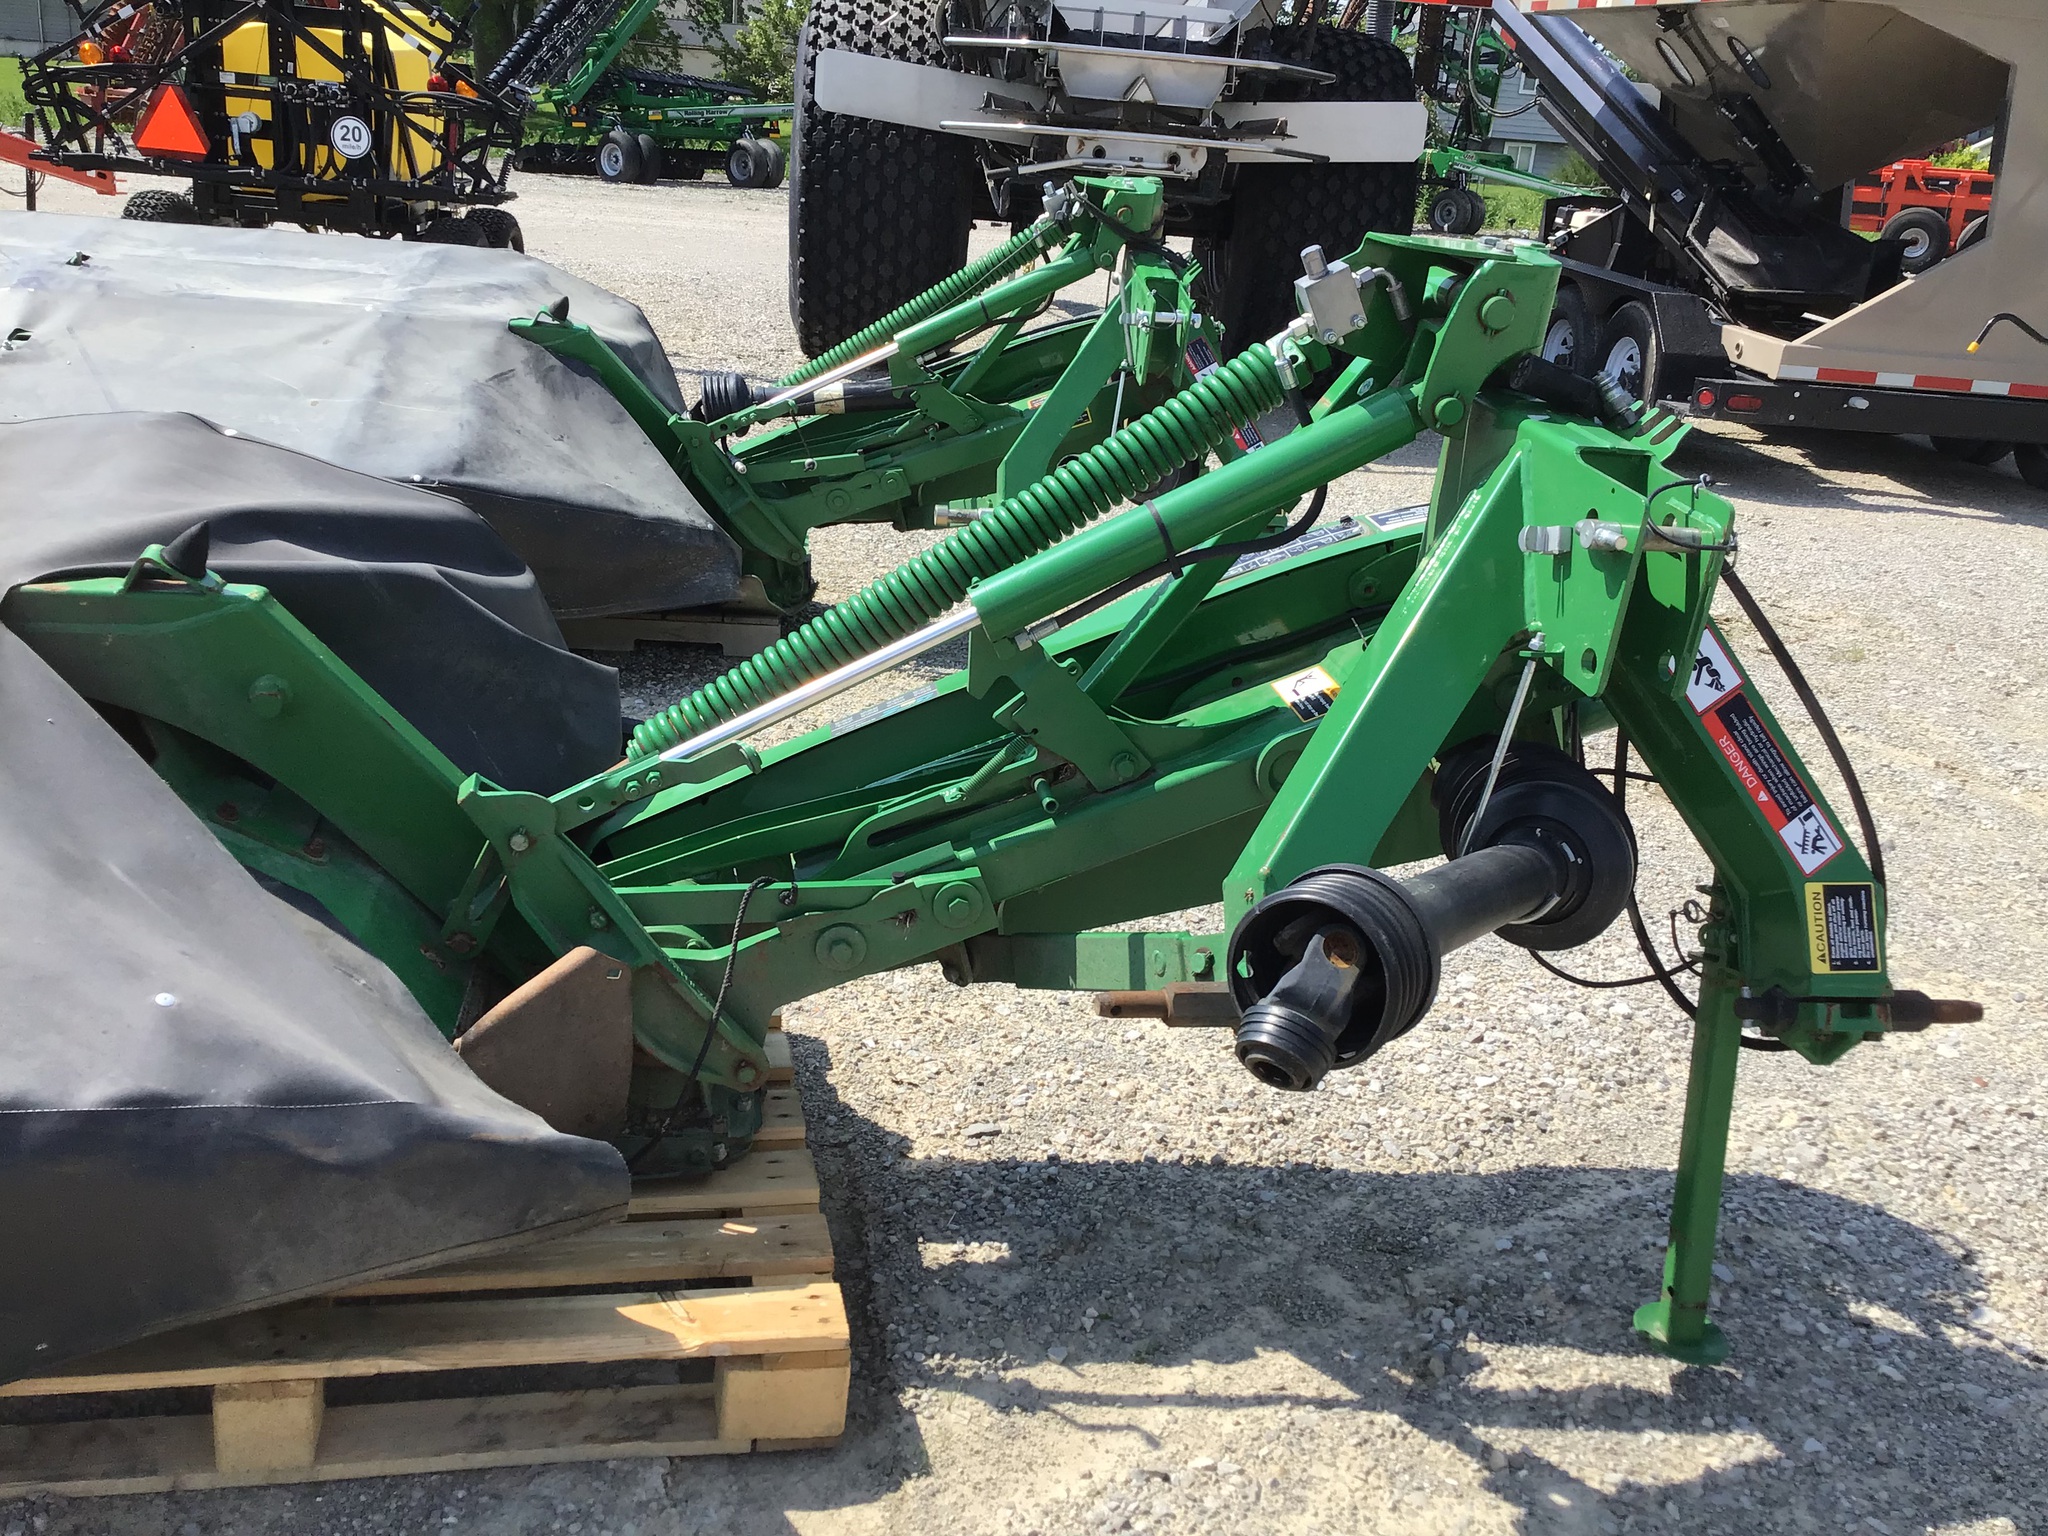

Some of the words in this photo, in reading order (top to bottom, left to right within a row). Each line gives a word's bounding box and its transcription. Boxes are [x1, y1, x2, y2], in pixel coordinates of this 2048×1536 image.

[340, 124, 362, 142] 20
[1730, 713, 1743, 730] folded
[1733, 730, 1744, 743] clear
[1741, 729, 1753, 745] being
[1742, 719, 1759, 742] hydraulic
[1741, 743, 1754, 758] stand
[1769, 747, 1781, 762] wings
[1719, 735, 1757, 788] DANGER
[1752, 758, 1764, 773] death
[1757, 754, 1769, 768] wings
[1761, 748, 1782, 778] Mechanical
[1767, 768, 1778, 783] when
[1779, 763, 1790, 776] allow
[1766, 779, 1778, 794] injury
[1789, 776, 1798, 786] can
[1775, 794, 1787, 808] avoid
[1777, 783, 1793, 805] machine
[1796, 786, 1808, 803] failure
[1812, 892, 1825, 952] CAUTION
